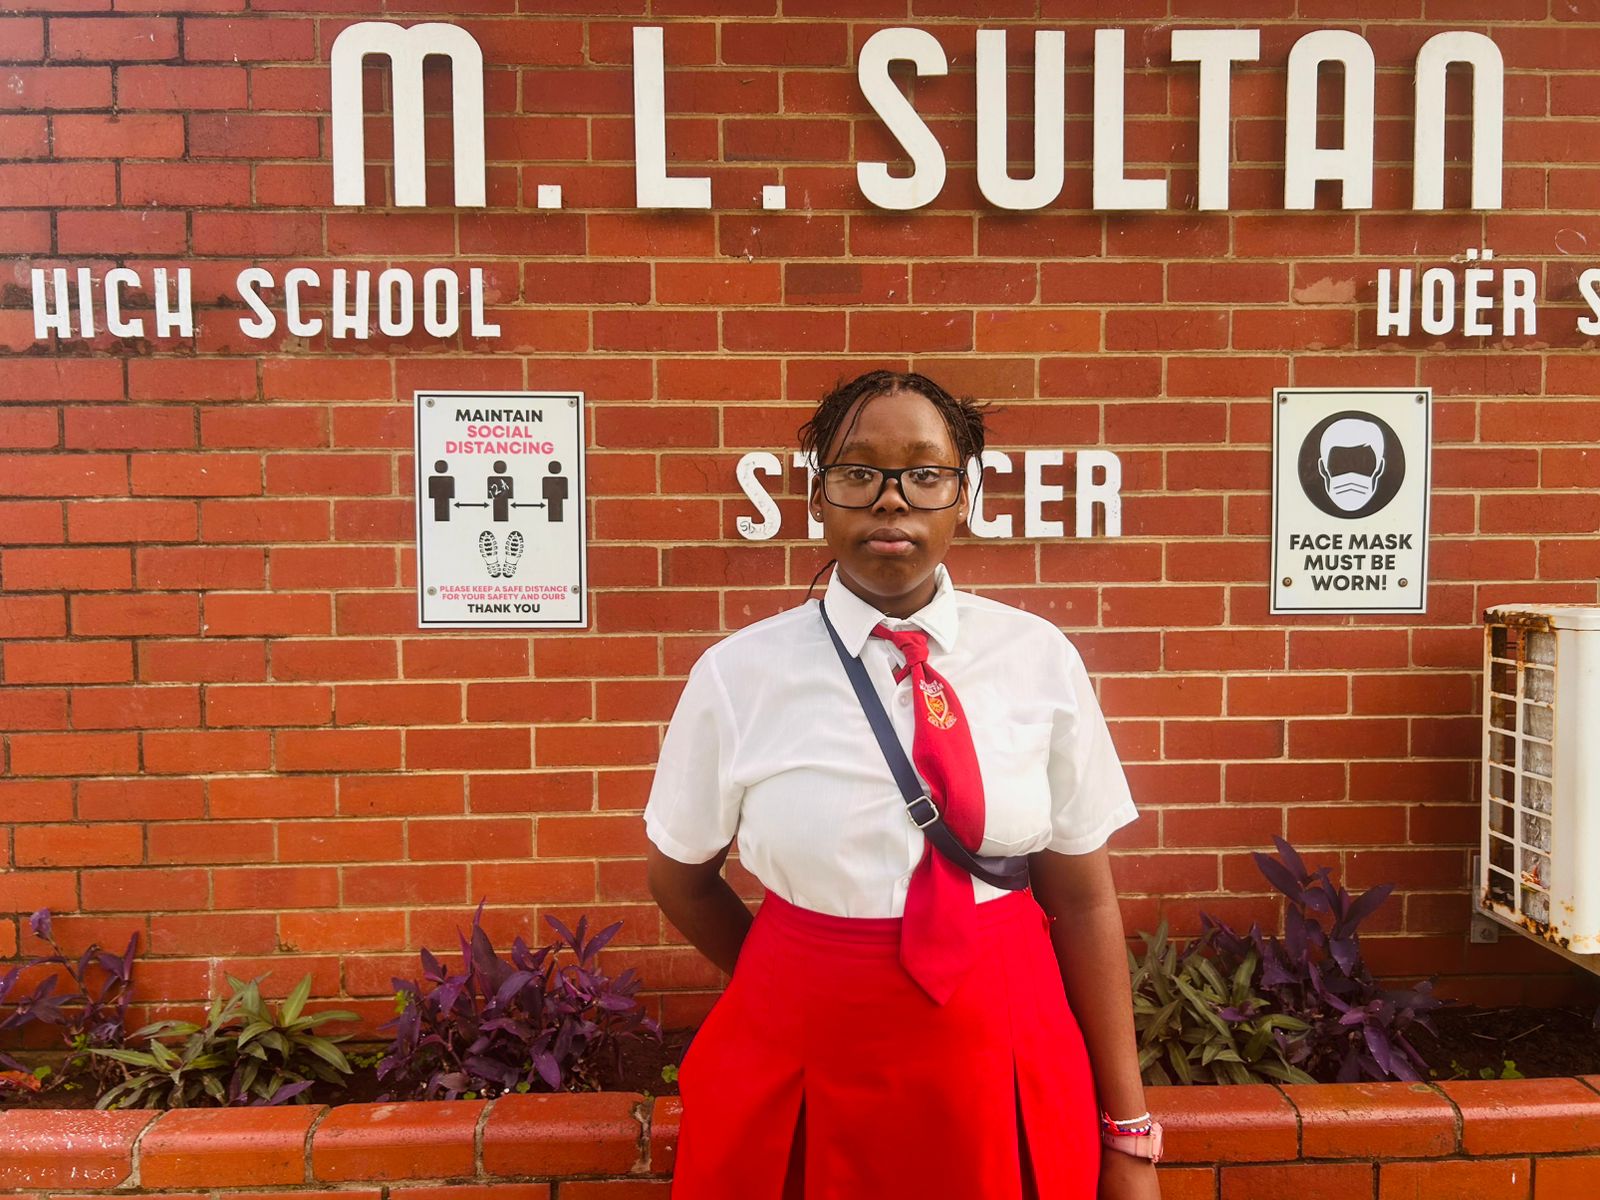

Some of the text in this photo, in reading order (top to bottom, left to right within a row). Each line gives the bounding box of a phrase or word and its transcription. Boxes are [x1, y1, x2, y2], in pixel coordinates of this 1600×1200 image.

[857, 27, 1504, 211] SULTAN
[1377, 248, 1537, 337] HOËR
[31, 267, 501, 340] HIGH SCHOOL
[455, 409, 544, 423] MAINTAIN
[467, 425, 533, 439] SOCIAL
[445, 441, 555, 455] DISTANCING
[1289, 533, 1413, 550] FACE MASK
[1303, 554, 1396, 571] MUST BE
[439, 585, 568, 593] PLEASE KEEP A SAFE DISTANCE
[1311, 574, 1388, 591] WORN!
[442, 593, 566, 601] FOR YOUR SAFETY AND OURS
[467, 603, 541, 613] THANK YOU
